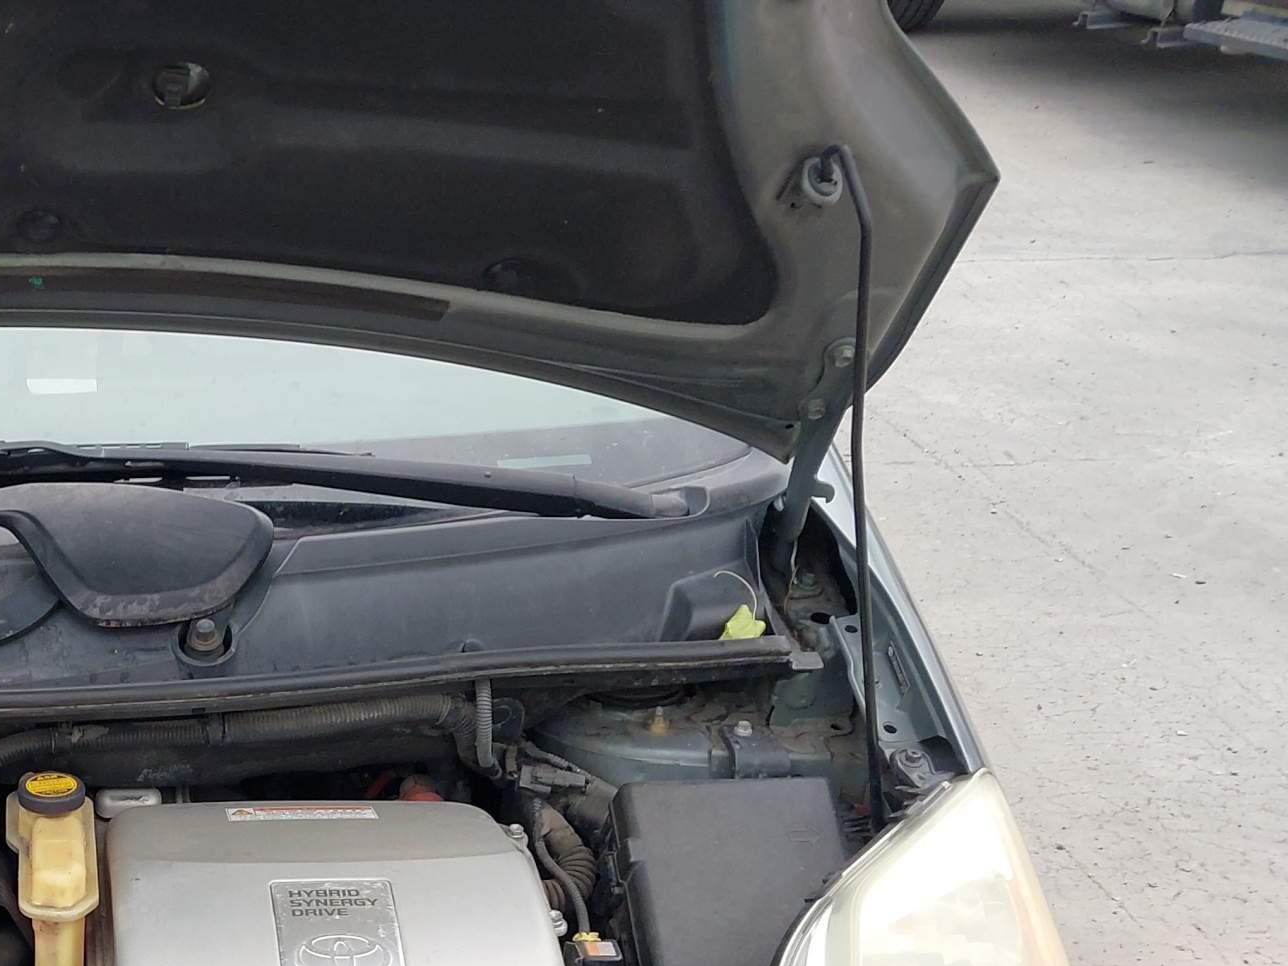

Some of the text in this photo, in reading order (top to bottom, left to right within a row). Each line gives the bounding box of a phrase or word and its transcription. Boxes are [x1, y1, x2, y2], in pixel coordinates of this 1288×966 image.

[288, 889, 360, 898] HYBRID
[289, 898, 378, 907] SYNERGY
[292, 908, 350, 917] DRIVE
